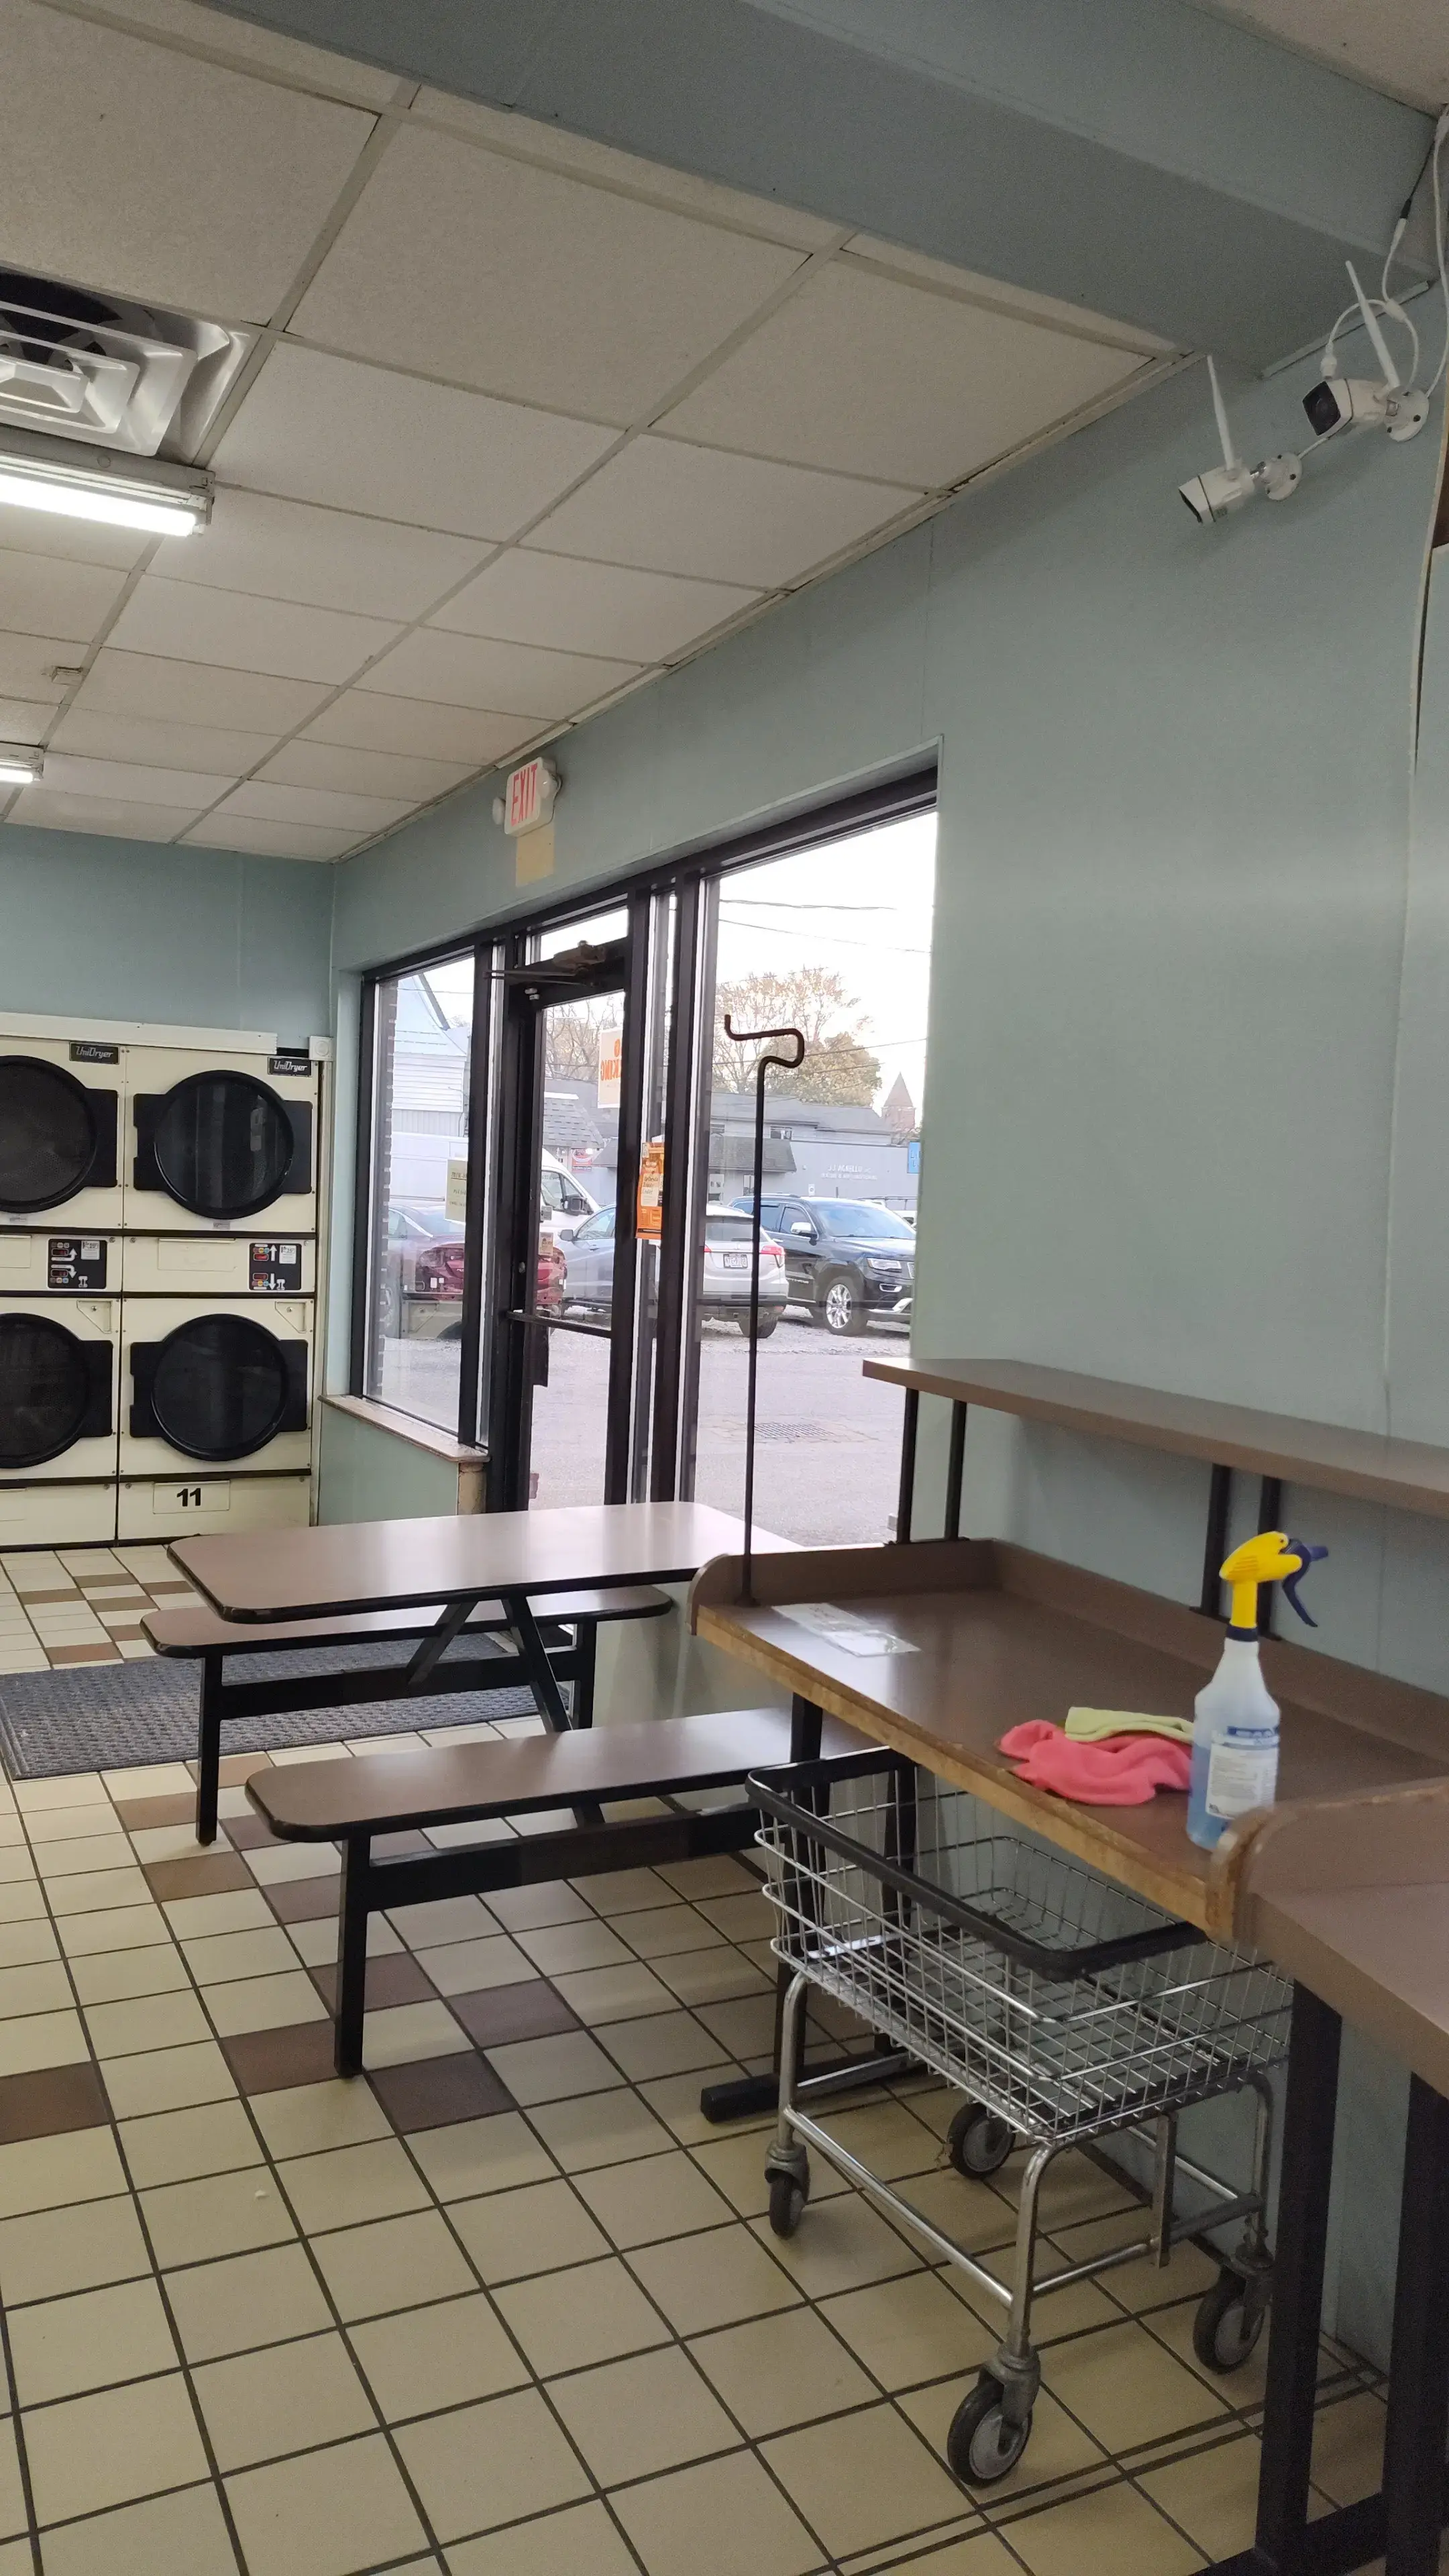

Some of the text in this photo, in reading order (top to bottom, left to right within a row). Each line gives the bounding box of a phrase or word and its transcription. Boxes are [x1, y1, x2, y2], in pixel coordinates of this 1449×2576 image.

[511, 762, 538, 826] EXIT
[76, 1046, 113, 1059] UniDryer
[273, 1060, 308, 1073] UniDryer
[176, 1487, 201, 1507] 11
